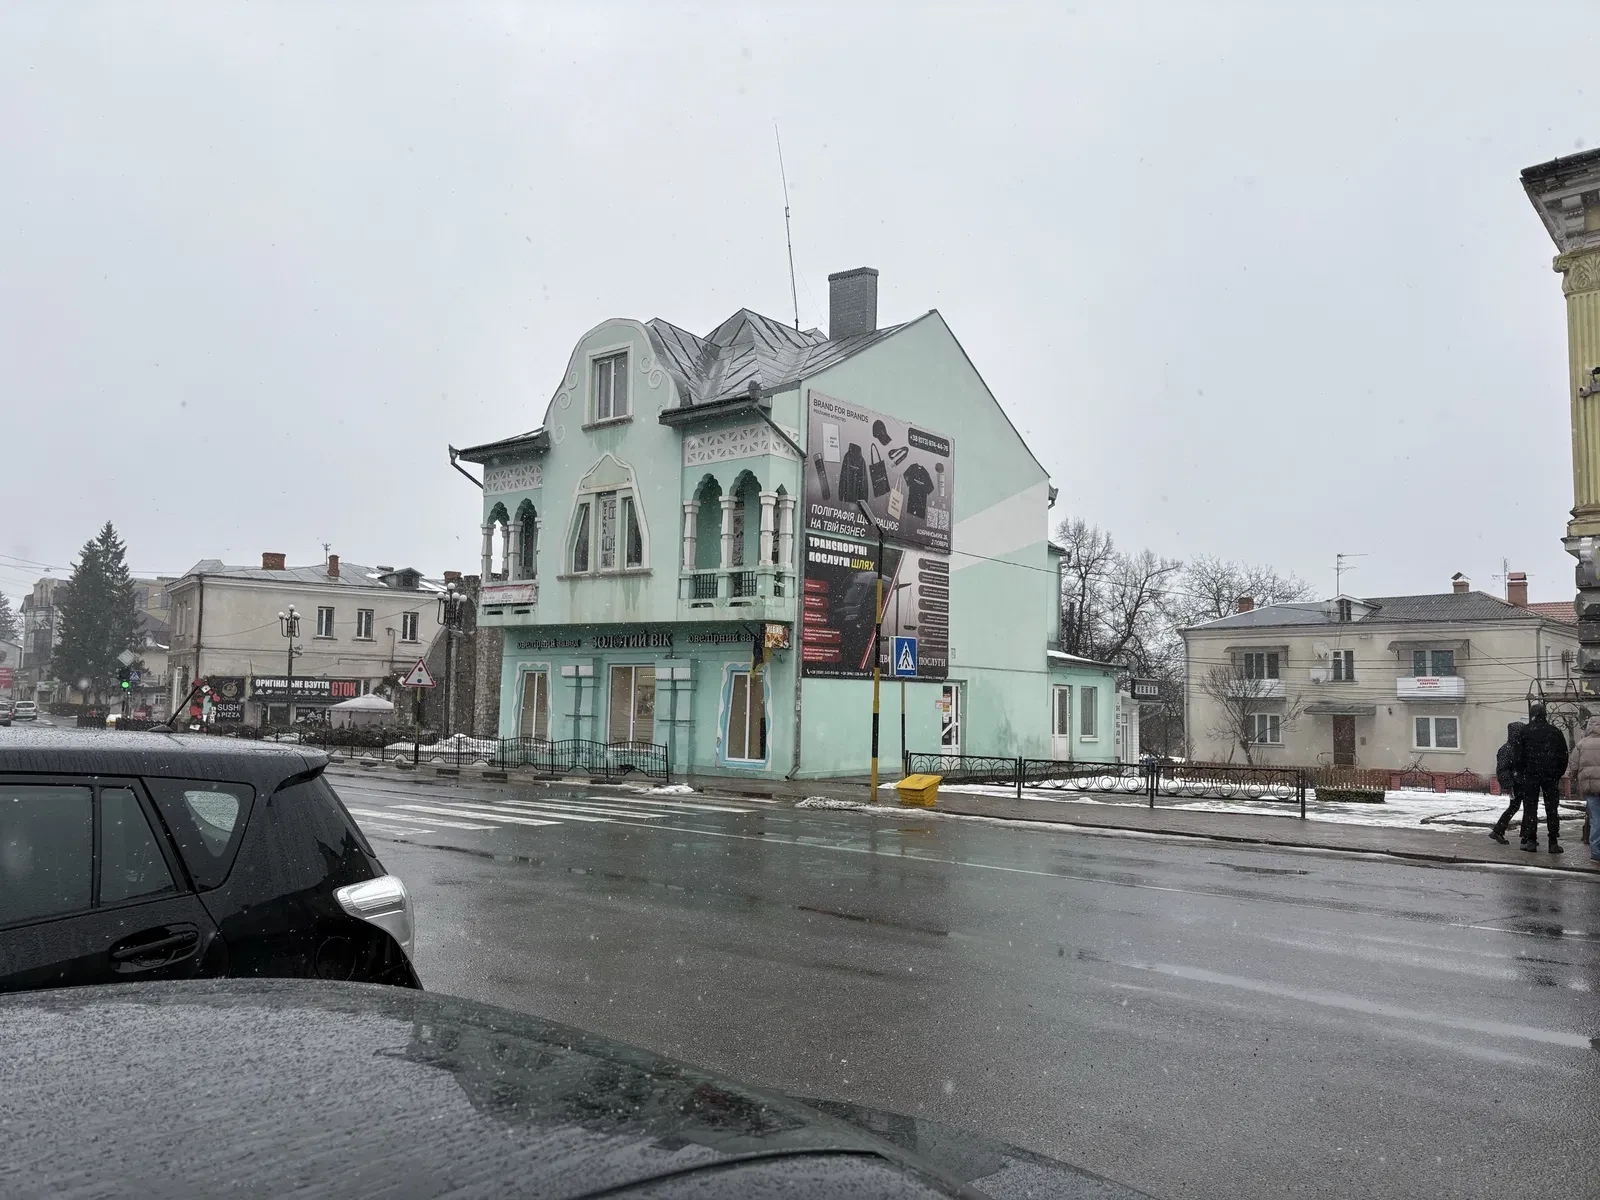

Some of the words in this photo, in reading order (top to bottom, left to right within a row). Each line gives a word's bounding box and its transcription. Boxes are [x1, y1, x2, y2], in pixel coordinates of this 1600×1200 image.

[813, 399, 833, 412] BRAND
[834, 406, 846, 416] FOR
[846, 410, 869, 423] BRANDS
[811, 504, 856, 524] ПОЛІГРАФІЯ,
[875, 517, 900, 531] РАЦЮЄ
[810, 518, 822, 529] НА
[823, 520, 840, 533] ТВІЙ
[840, 524, 866, 537] БІЗНЕС
[808, 536, 868, 556] ТРАНСПОРТНІ
[808, 551, 851, 567] ПОСЛУГИ
[851, 558, 875, 571] ШЛЯХ
[591, 630, 647, 649] ЗОЛОТИЙ
[650, 633, 671, 647] ВІК
[918, 657, 946, 667] ПОСЛУГИ
[304, 680, 330, 689] ВЗУТТЯ
[331, 681, 357, 697] СТОК
